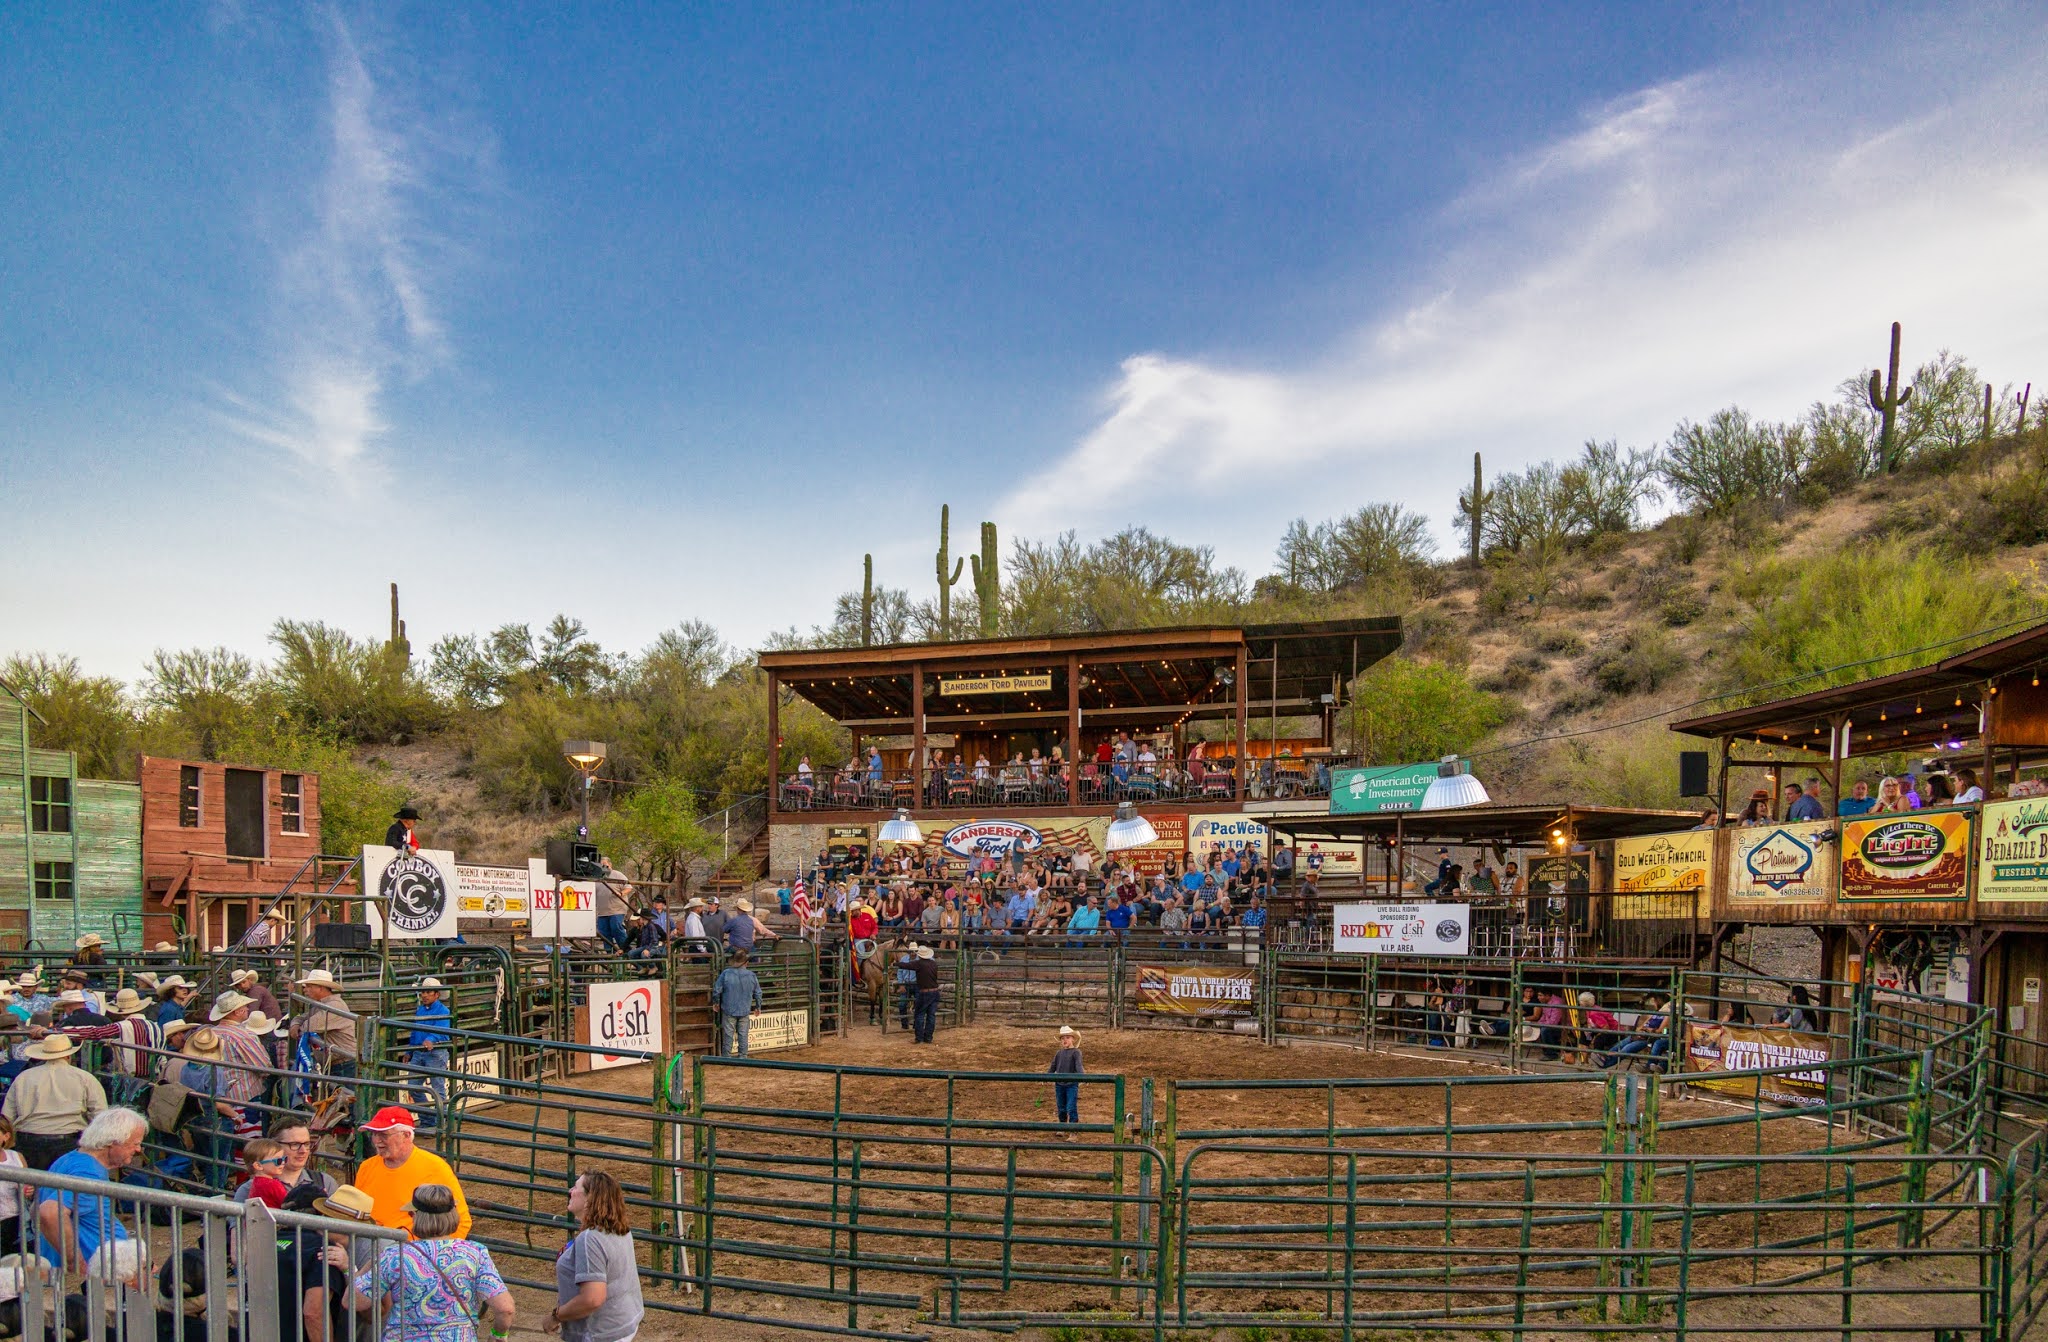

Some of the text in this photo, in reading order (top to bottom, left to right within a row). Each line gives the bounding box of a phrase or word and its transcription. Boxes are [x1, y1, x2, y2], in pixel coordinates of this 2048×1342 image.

[943, 677, 1049, 694] SANDERSON FORD PAVILION
[1368, 772, 1438, 788] American Centu
[1152, 821, 1183, 829] KENZIE
[1890, 822, 1936, 832] Let There Be
[951, 826, 1032, 846] SANDERSO
[976, 837, 1010, 855] Ford
[1867, 834, 1938, 856] Light
[1985, 837, 2036, 861] BEDAZZLE
[1619, 850, 1706, 867] GOLD WEALTH FINANCIAL
[1757, 847, 1798, 871] Platinum
[387, 858, 440, 886] COWBOY
[1538, 870, 1578, 882] SMOKE WAON
[1998, 866, 2037, 878] WESTERN
[1623, 869, 1667, 893] BUY GOLD
[574, 890, 593, 910] TV
[1779, 887, 1824, 897] 480-326-6521
[389, 910, 440, 935] CHANNEL
[1340, 924, 1395, 938] RFD TV
[1401, 923, 1424, 935] dish
[1380, 944, 1415, 953] V.I.P. AREA
[1171, 976, 1252, 987] JUNIOR WORLD FINALS
[1170, 982, 1252, 1001] QUALIFIER
[601, 999, 650, 1042] dish
[749, 1016, 780, 1030] OOTHILLS
[1727, 1040, 1826, 1062] JUNIOR WORLD FINALS
[1724, 1050, 1826, 1083] QUALIFIER
